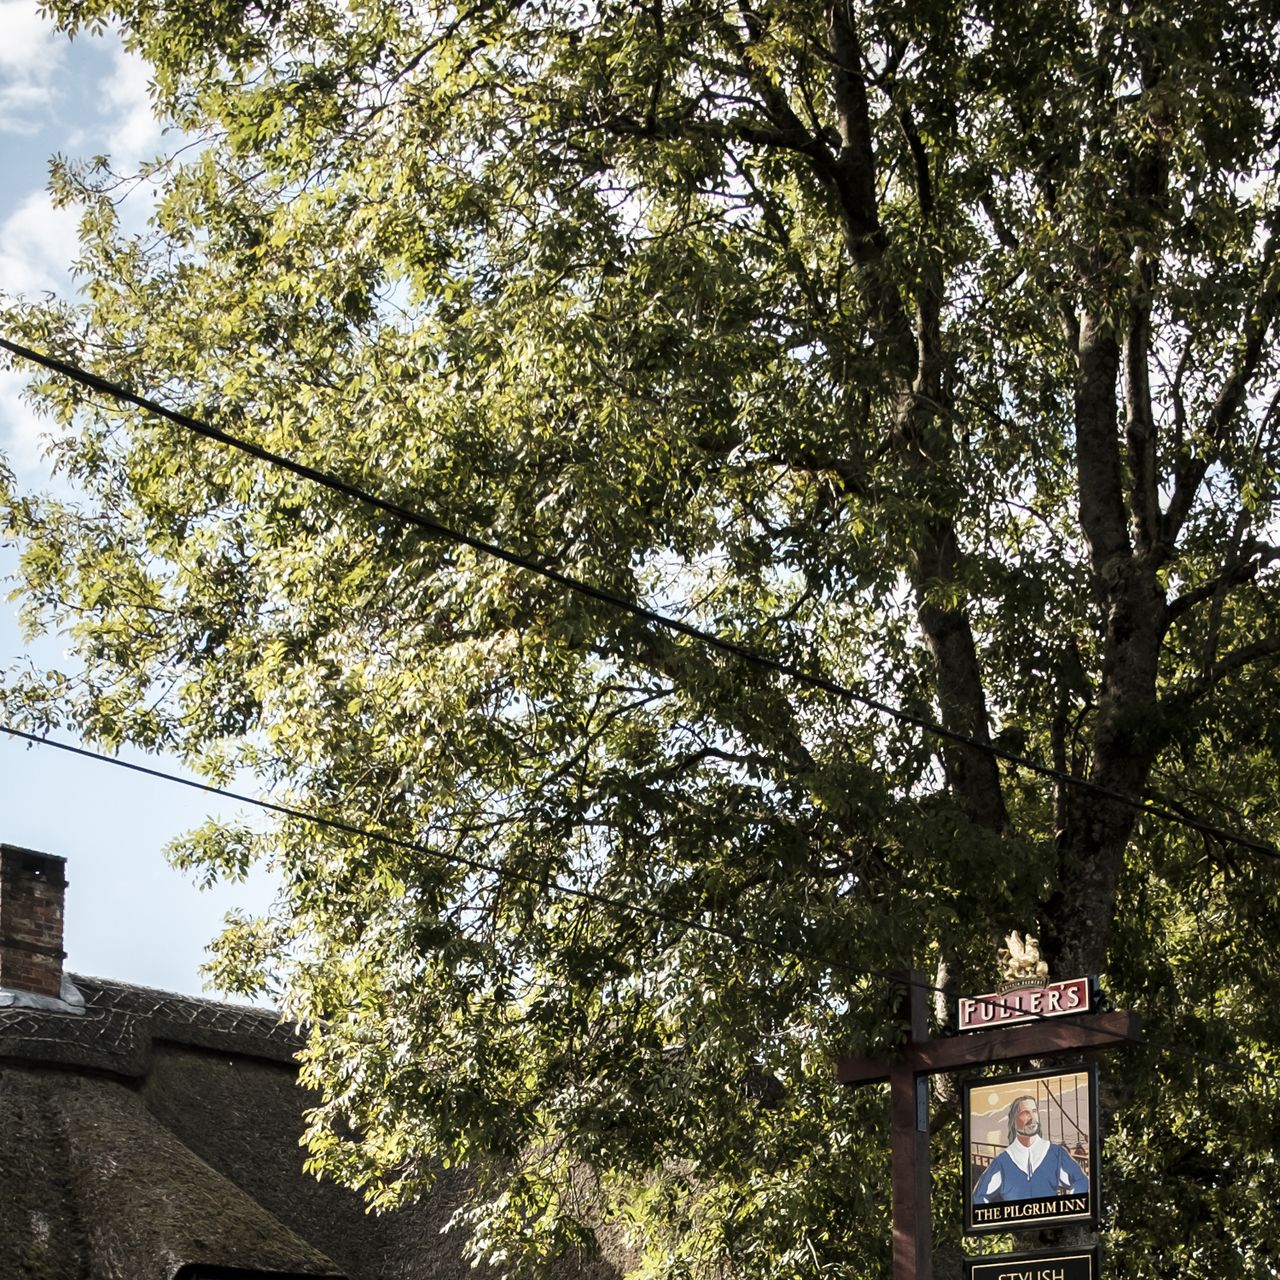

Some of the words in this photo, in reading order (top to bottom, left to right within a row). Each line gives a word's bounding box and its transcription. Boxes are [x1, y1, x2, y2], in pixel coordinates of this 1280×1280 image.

[964, 984, 1080, 1023] FULLER'S
[975, 1207, 1002, 1221] THE
[1004, 1202, 1057, 1218] PILGRIM
[1060, 1198, 1087, 1213] INN
